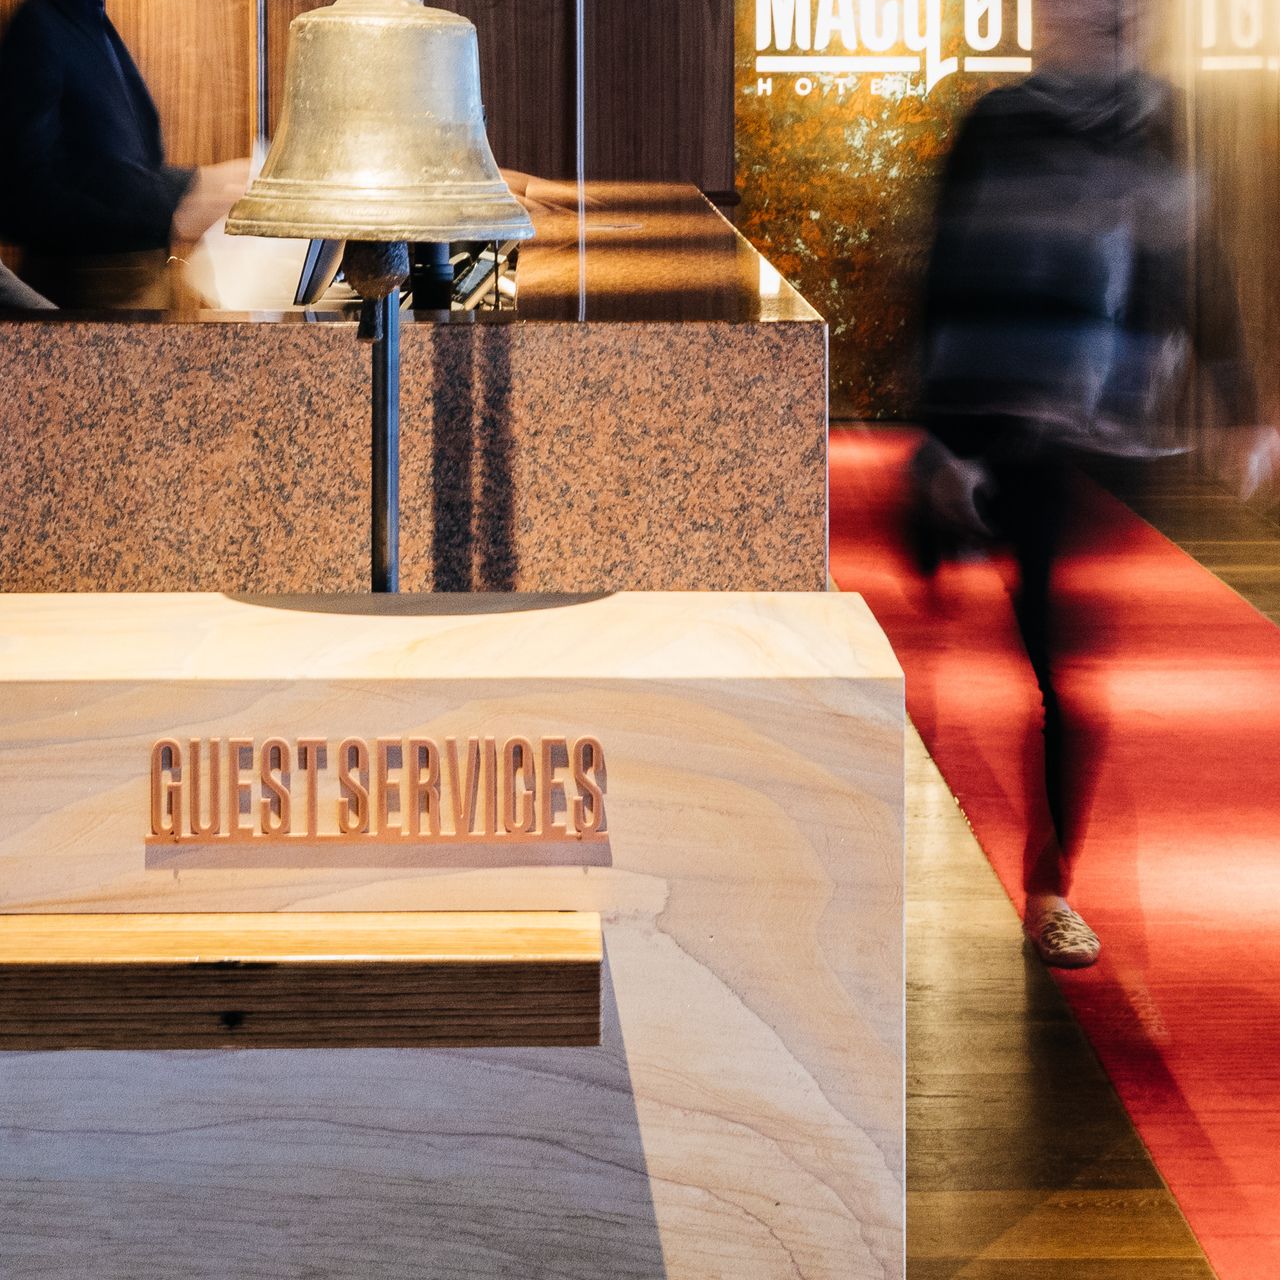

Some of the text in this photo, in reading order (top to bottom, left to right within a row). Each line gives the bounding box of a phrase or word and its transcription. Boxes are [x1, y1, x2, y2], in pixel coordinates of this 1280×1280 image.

[757, 77, 923, 97] HOTEL
[150, 735, 607, 836] GUEST SERVICES
